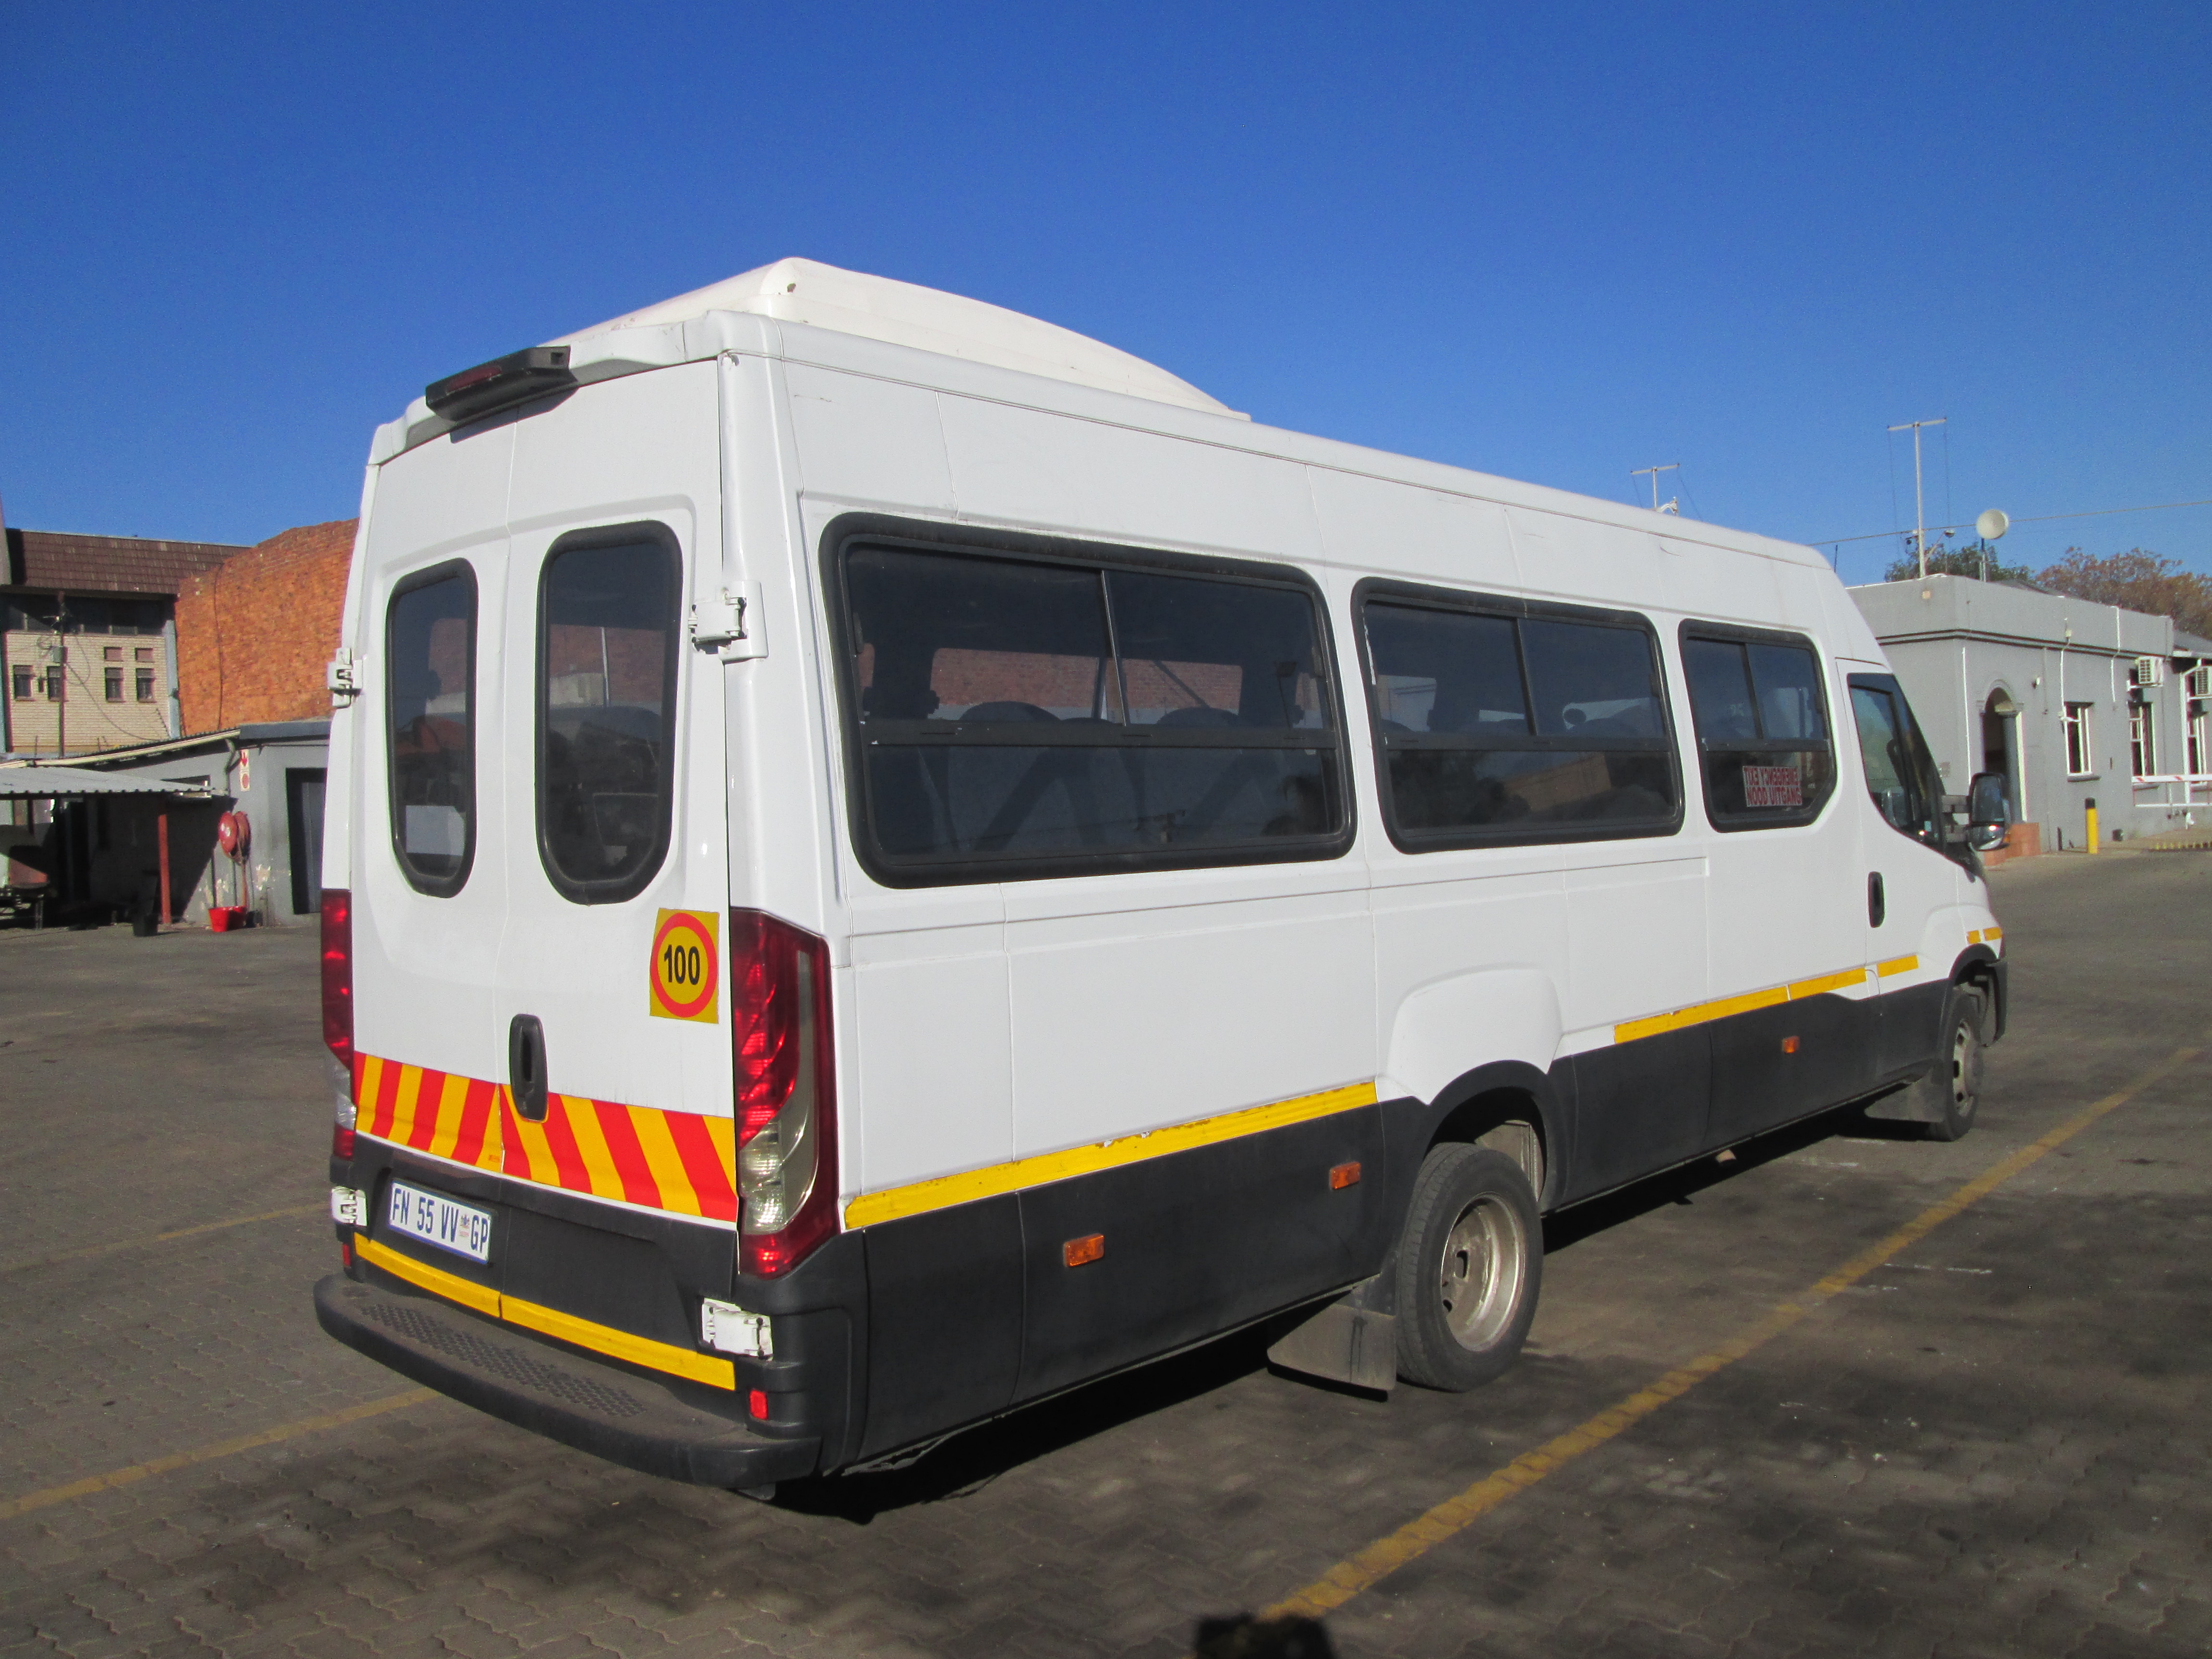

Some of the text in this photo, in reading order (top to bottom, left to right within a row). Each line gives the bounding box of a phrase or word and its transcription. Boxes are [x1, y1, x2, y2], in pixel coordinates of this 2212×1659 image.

[664, 944, 700, 985] 100
[393, 1188, 489, 1253] FN 55 VV GP
